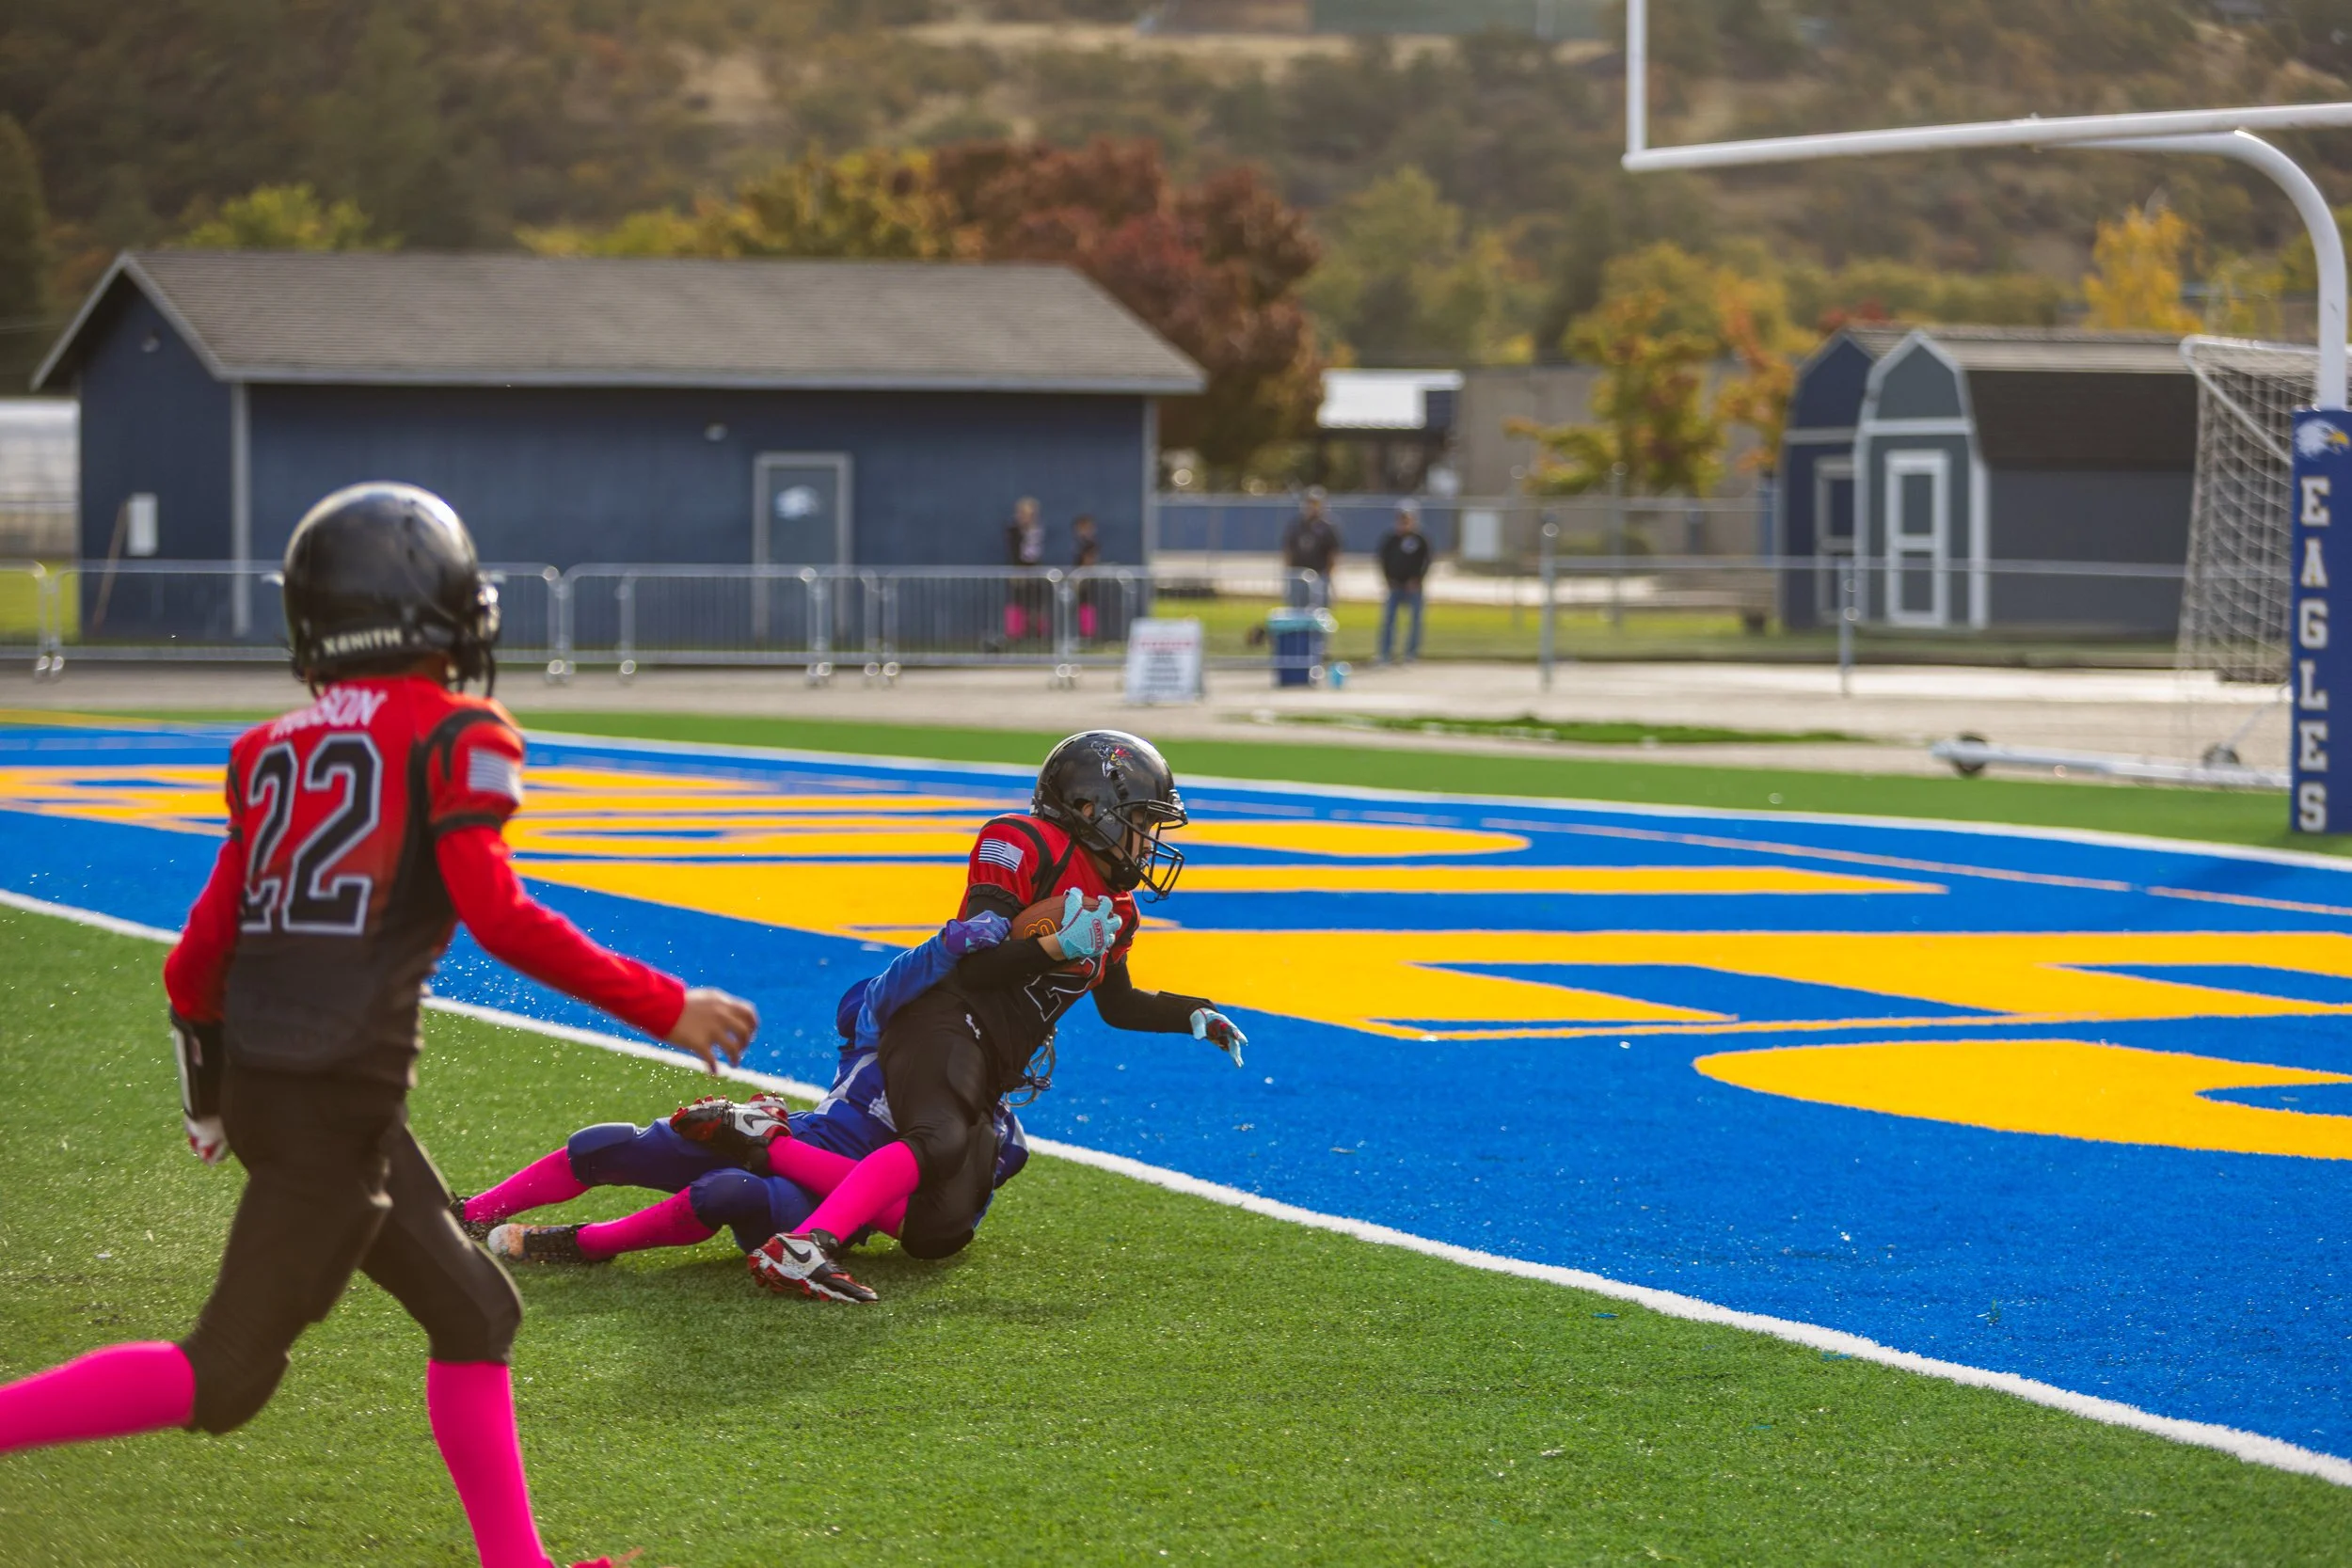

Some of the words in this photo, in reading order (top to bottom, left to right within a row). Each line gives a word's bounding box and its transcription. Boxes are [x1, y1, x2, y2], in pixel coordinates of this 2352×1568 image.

[322, 626, 404, 657] XENITH
[2299, 477, 2330, 832] EAGLES
[241, 733, 382, 934] 22
